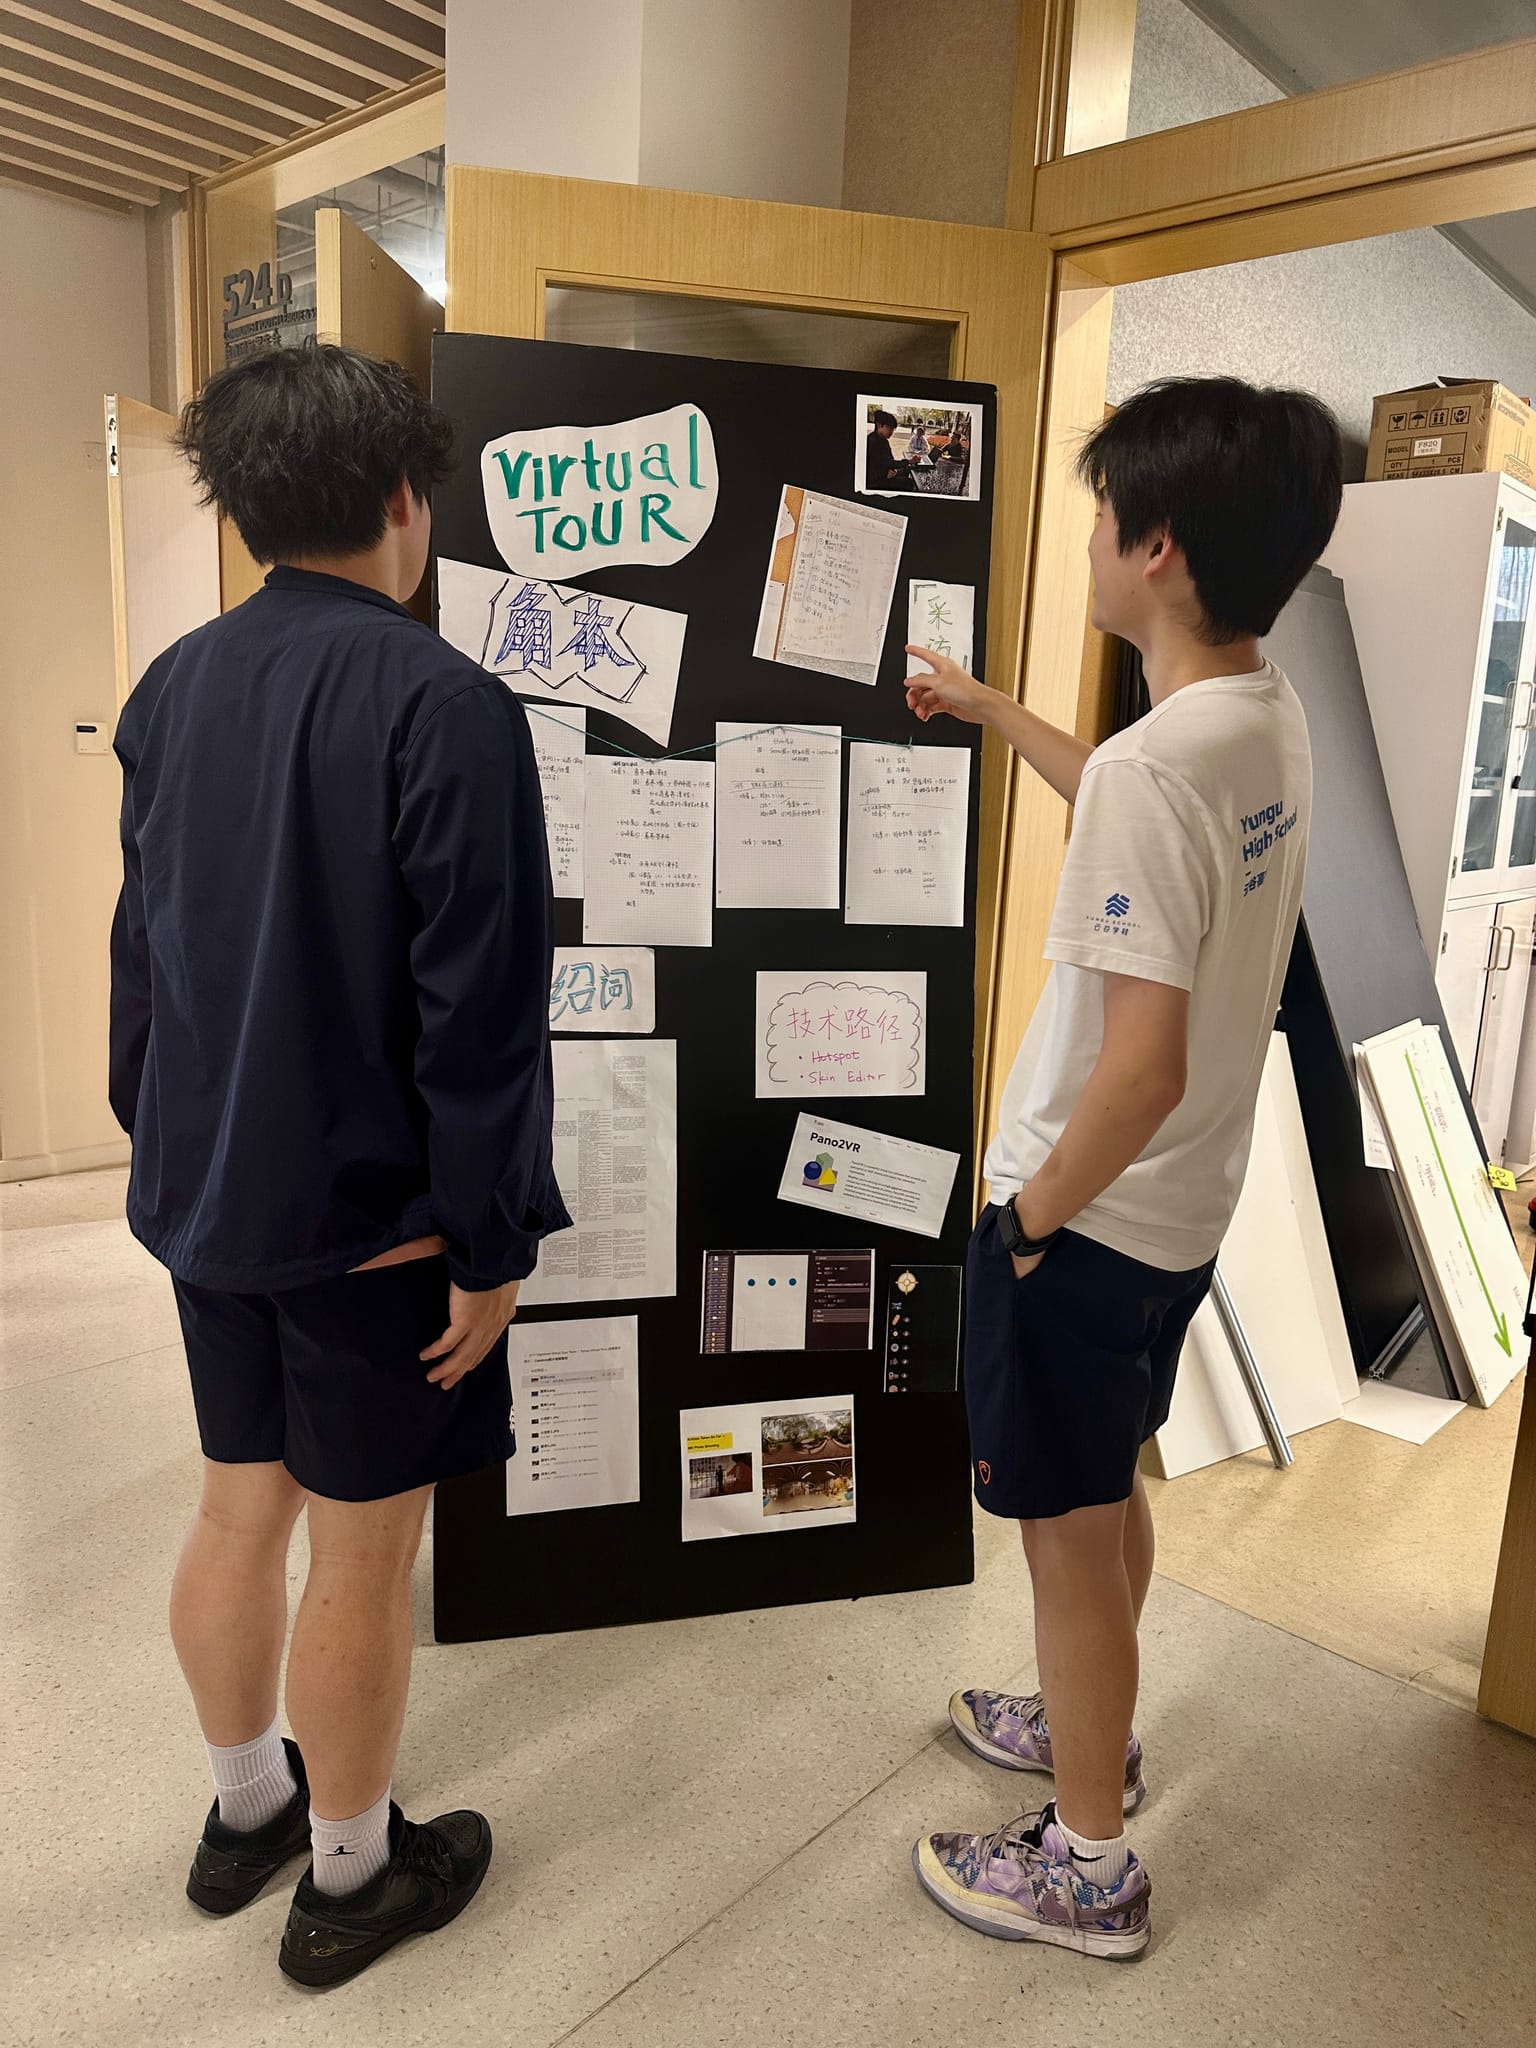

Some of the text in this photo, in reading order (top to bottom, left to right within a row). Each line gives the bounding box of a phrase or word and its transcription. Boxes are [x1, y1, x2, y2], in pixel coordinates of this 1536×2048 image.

[491, 413, 707, 503] Virtual
[1387, 445, 1409, 454] MODEL
[1390, 461, 1403, 469] QTY
[1447, 456, 1462, 464] PCS
[1240, 800, 1283, 834] Yungu
[1243, 830, 1273, 862] High
[785, 1005, 903, 1045] 技术路径
[811, 1050, 861, 1065] Hotspot
[808, 1071, 887, 1085] Skin Editor
[809, 1131, 862, 1154] Pano2VR
